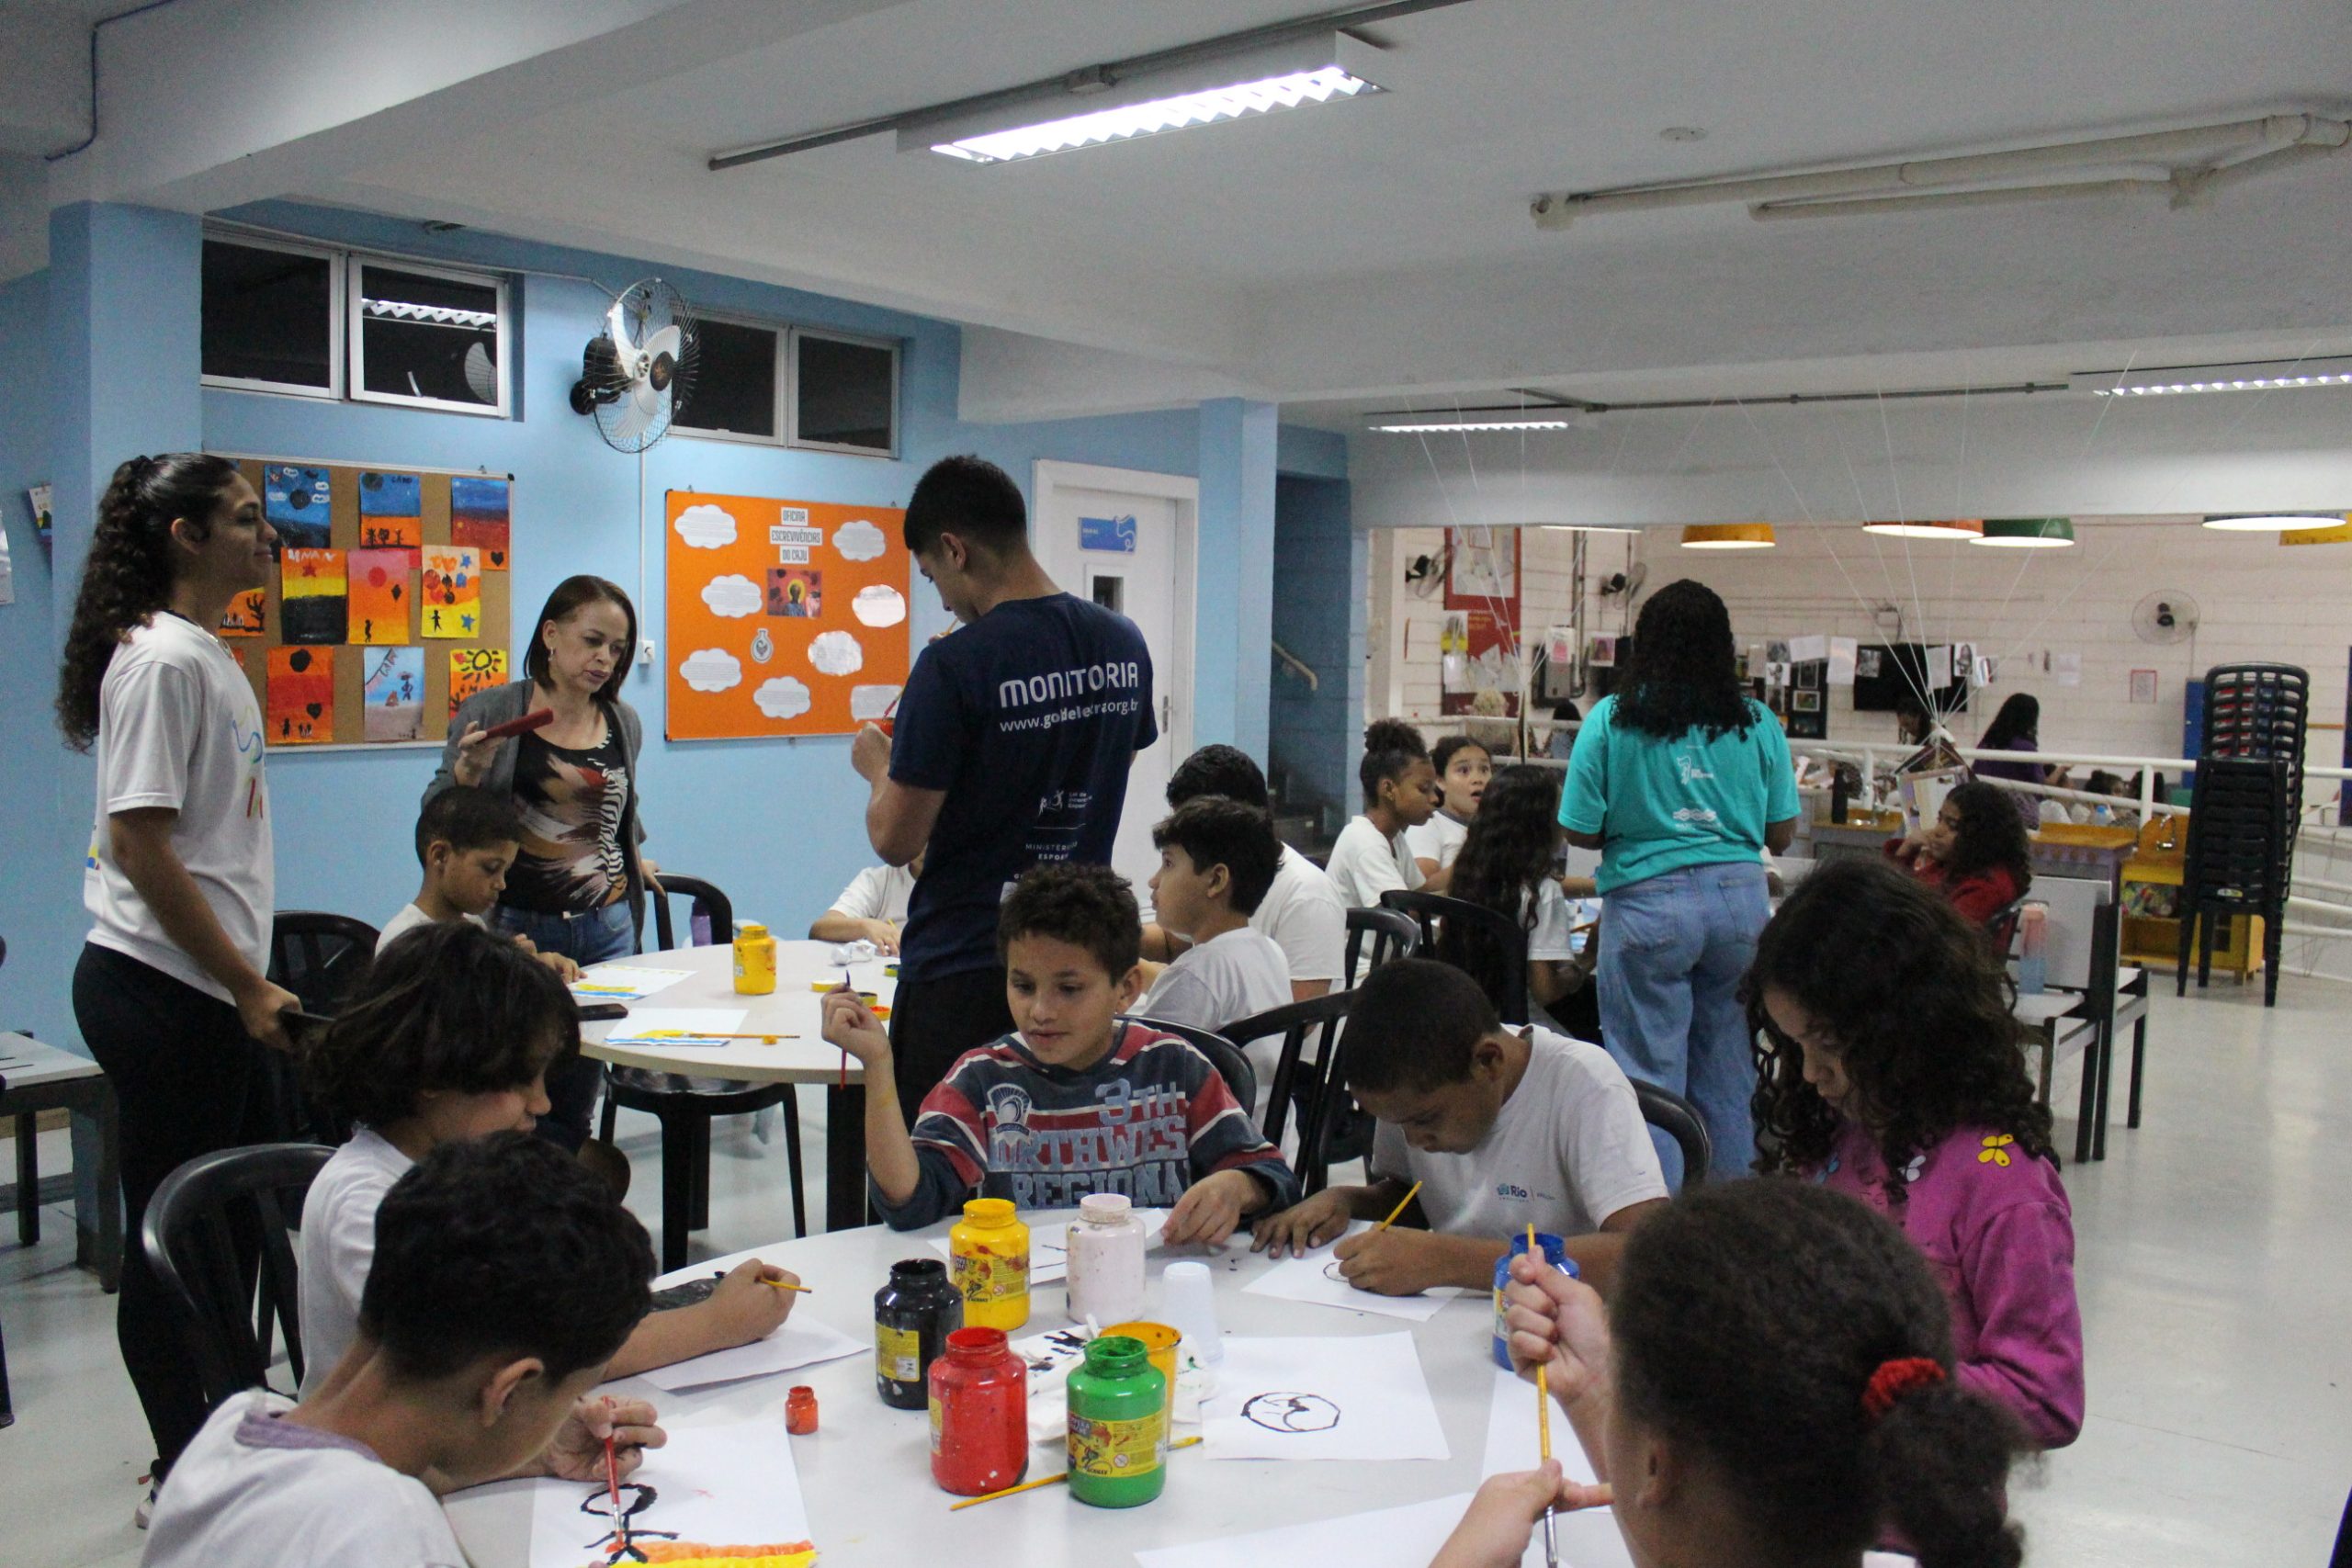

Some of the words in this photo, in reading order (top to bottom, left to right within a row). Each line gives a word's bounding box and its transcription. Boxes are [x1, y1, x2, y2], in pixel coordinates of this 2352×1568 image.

[783, 510, 806, 522] OFICINA
[772, 529, 820, 543] ESCREVIVÊNCIAS
[1000, 661, 1139, 708] MONITORIA
[1510, 1185, 1527, 1198] Rio
